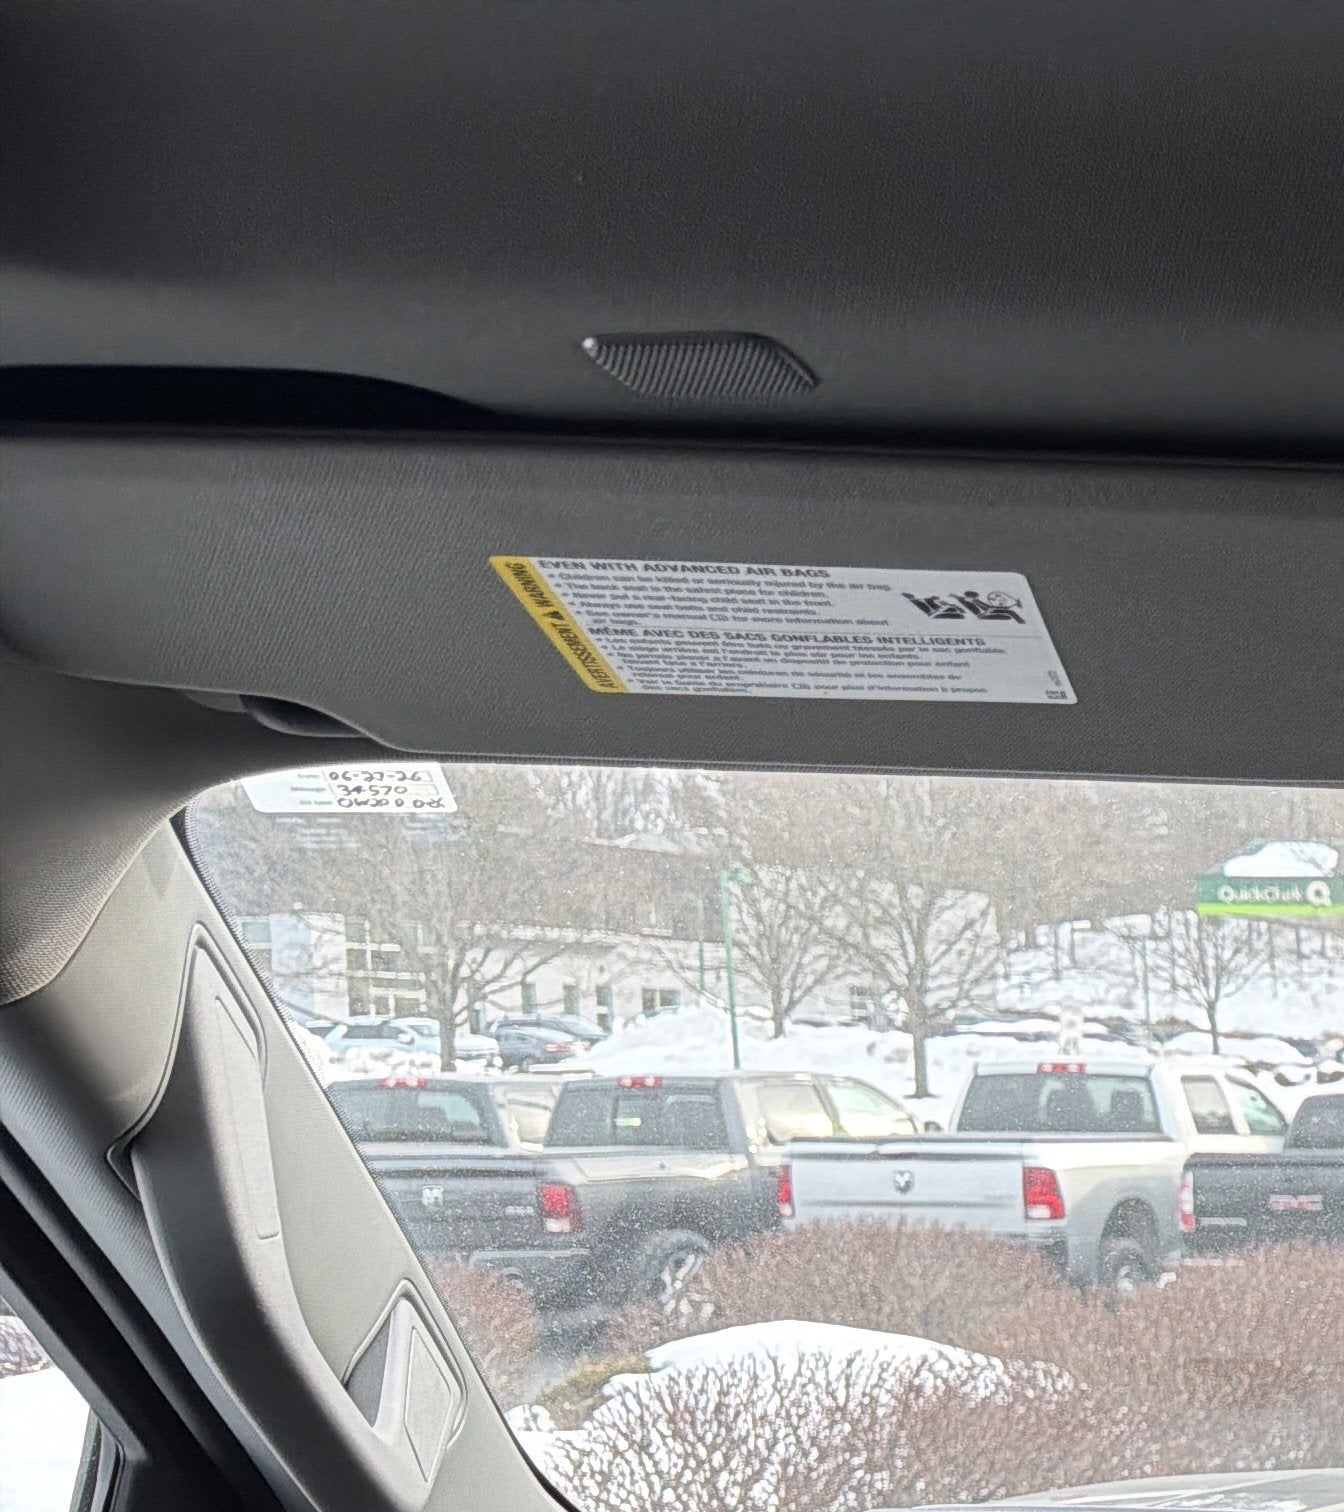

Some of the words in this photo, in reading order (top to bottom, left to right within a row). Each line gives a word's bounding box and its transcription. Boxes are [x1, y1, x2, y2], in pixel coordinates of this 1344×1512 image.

[538, 560, 586, 569] EVEN
[589, 562, 638, 571] WITH
[643, 563, 740, 575] ADVANCED
[745, 567, 777, 576] AIR
[780, 568, 831, 578] BAGS
[643, 630, 684, 638] AVEC
[687, 631, 720, 640] DES
[723, 632, 767, 641] SACS
[876, 636, 986, 646] INTELLIGENTS
